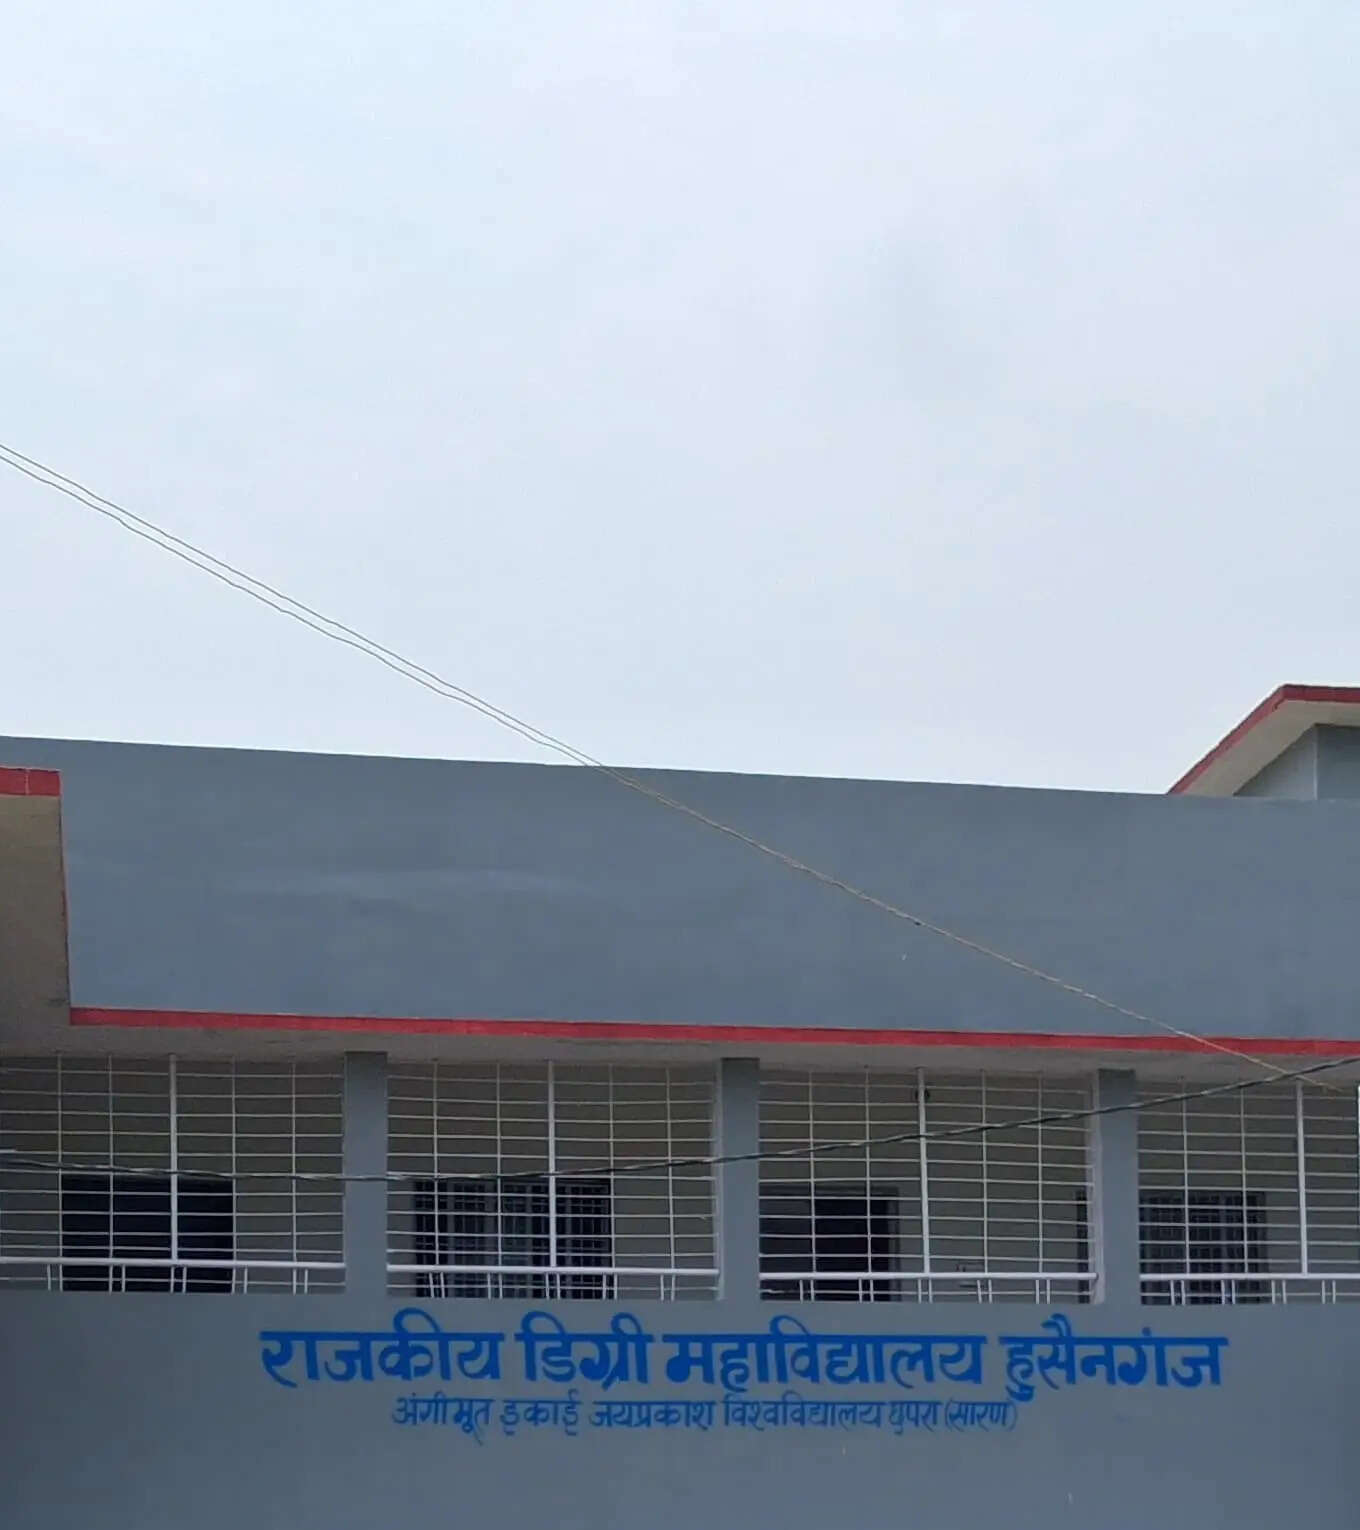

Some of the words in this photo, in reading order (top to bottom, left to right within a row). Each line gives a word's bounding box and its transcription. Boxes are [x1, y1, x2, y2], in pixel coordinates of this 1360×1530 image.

[259, 1307, 506, 1388] राजकीय
[514, 1310, 655, 1390] डिग्री
[662, 1315, 987, 1393] महाविद्यालय
[998, 1313, 1230, 1401] हुसैनगंज
[589, 1400, 717, 1431] जयप्रकाश
[721, 1390, 888, 1431] विश्वविद्यालय
